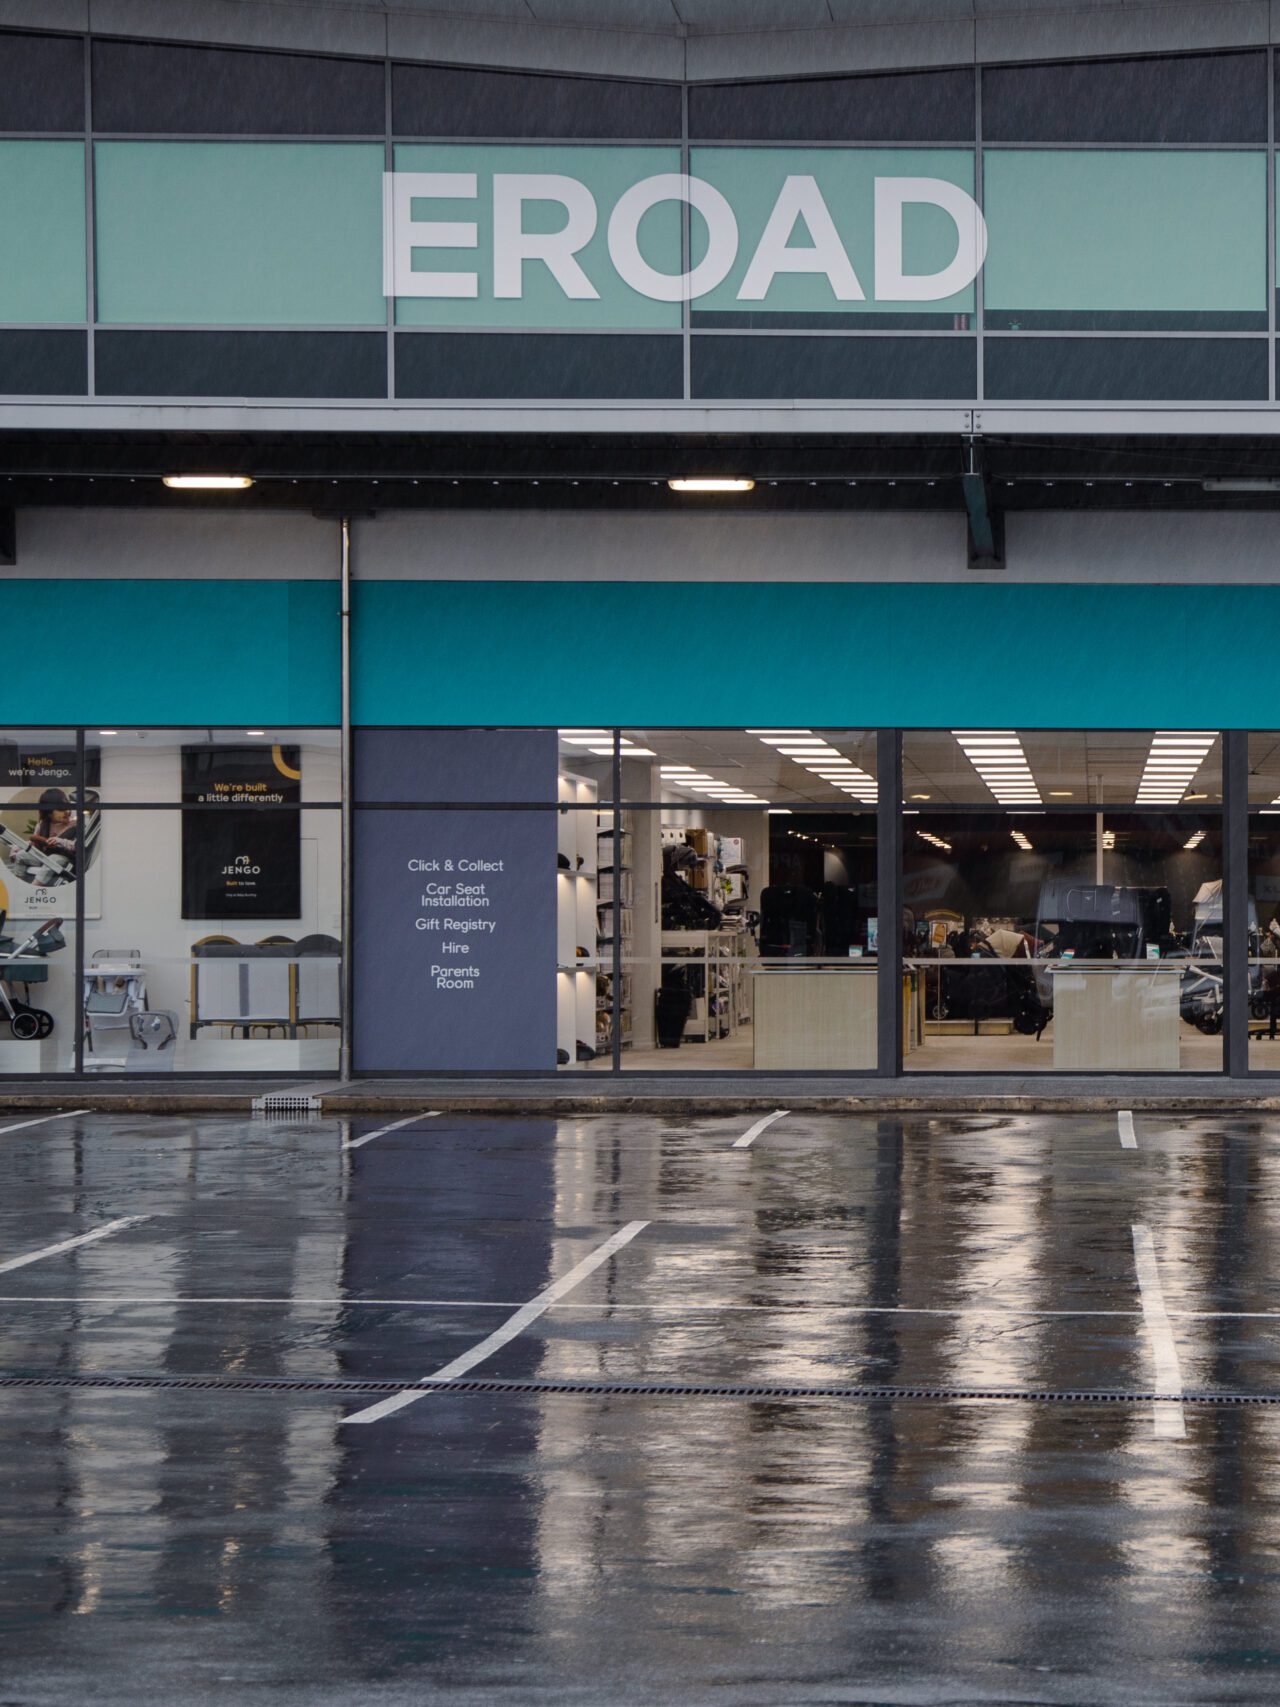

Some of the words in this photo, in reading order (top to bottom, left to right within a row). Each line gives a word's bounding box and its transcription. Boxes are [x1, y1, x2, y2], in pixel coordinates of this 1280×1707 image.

[383, 172, 988, 301] EROAD
[27, 757, 54, 766] Hello
[8, 768, 36, 776] we're
[38, 768, 72, 778] Jengo.
[214, 783, 243, 791] We're
[245, 783, 267, 791] built
[206, 793, 229, 802] little
[231, 793, 283, 803] differently
[221, 866, 261, 874] JENGO
[407, 859, 440, 871] Click
[444, 859, 454, 871] &
[458, 859, 504, 871] Collect
[426, 883, 452, 895] Car
[455, 883, 486, 895] Seat
[24, 896, 57, 904] JENGO
[421, 895, 490, 907] Installation
[415, 918, 440, 930] Gift
[444, 918, 496, 933] Registry
[442, 942, 470, 953] Hire
[431, 965, 480, 977] Parents
[436, 977, 474, 989] Room
